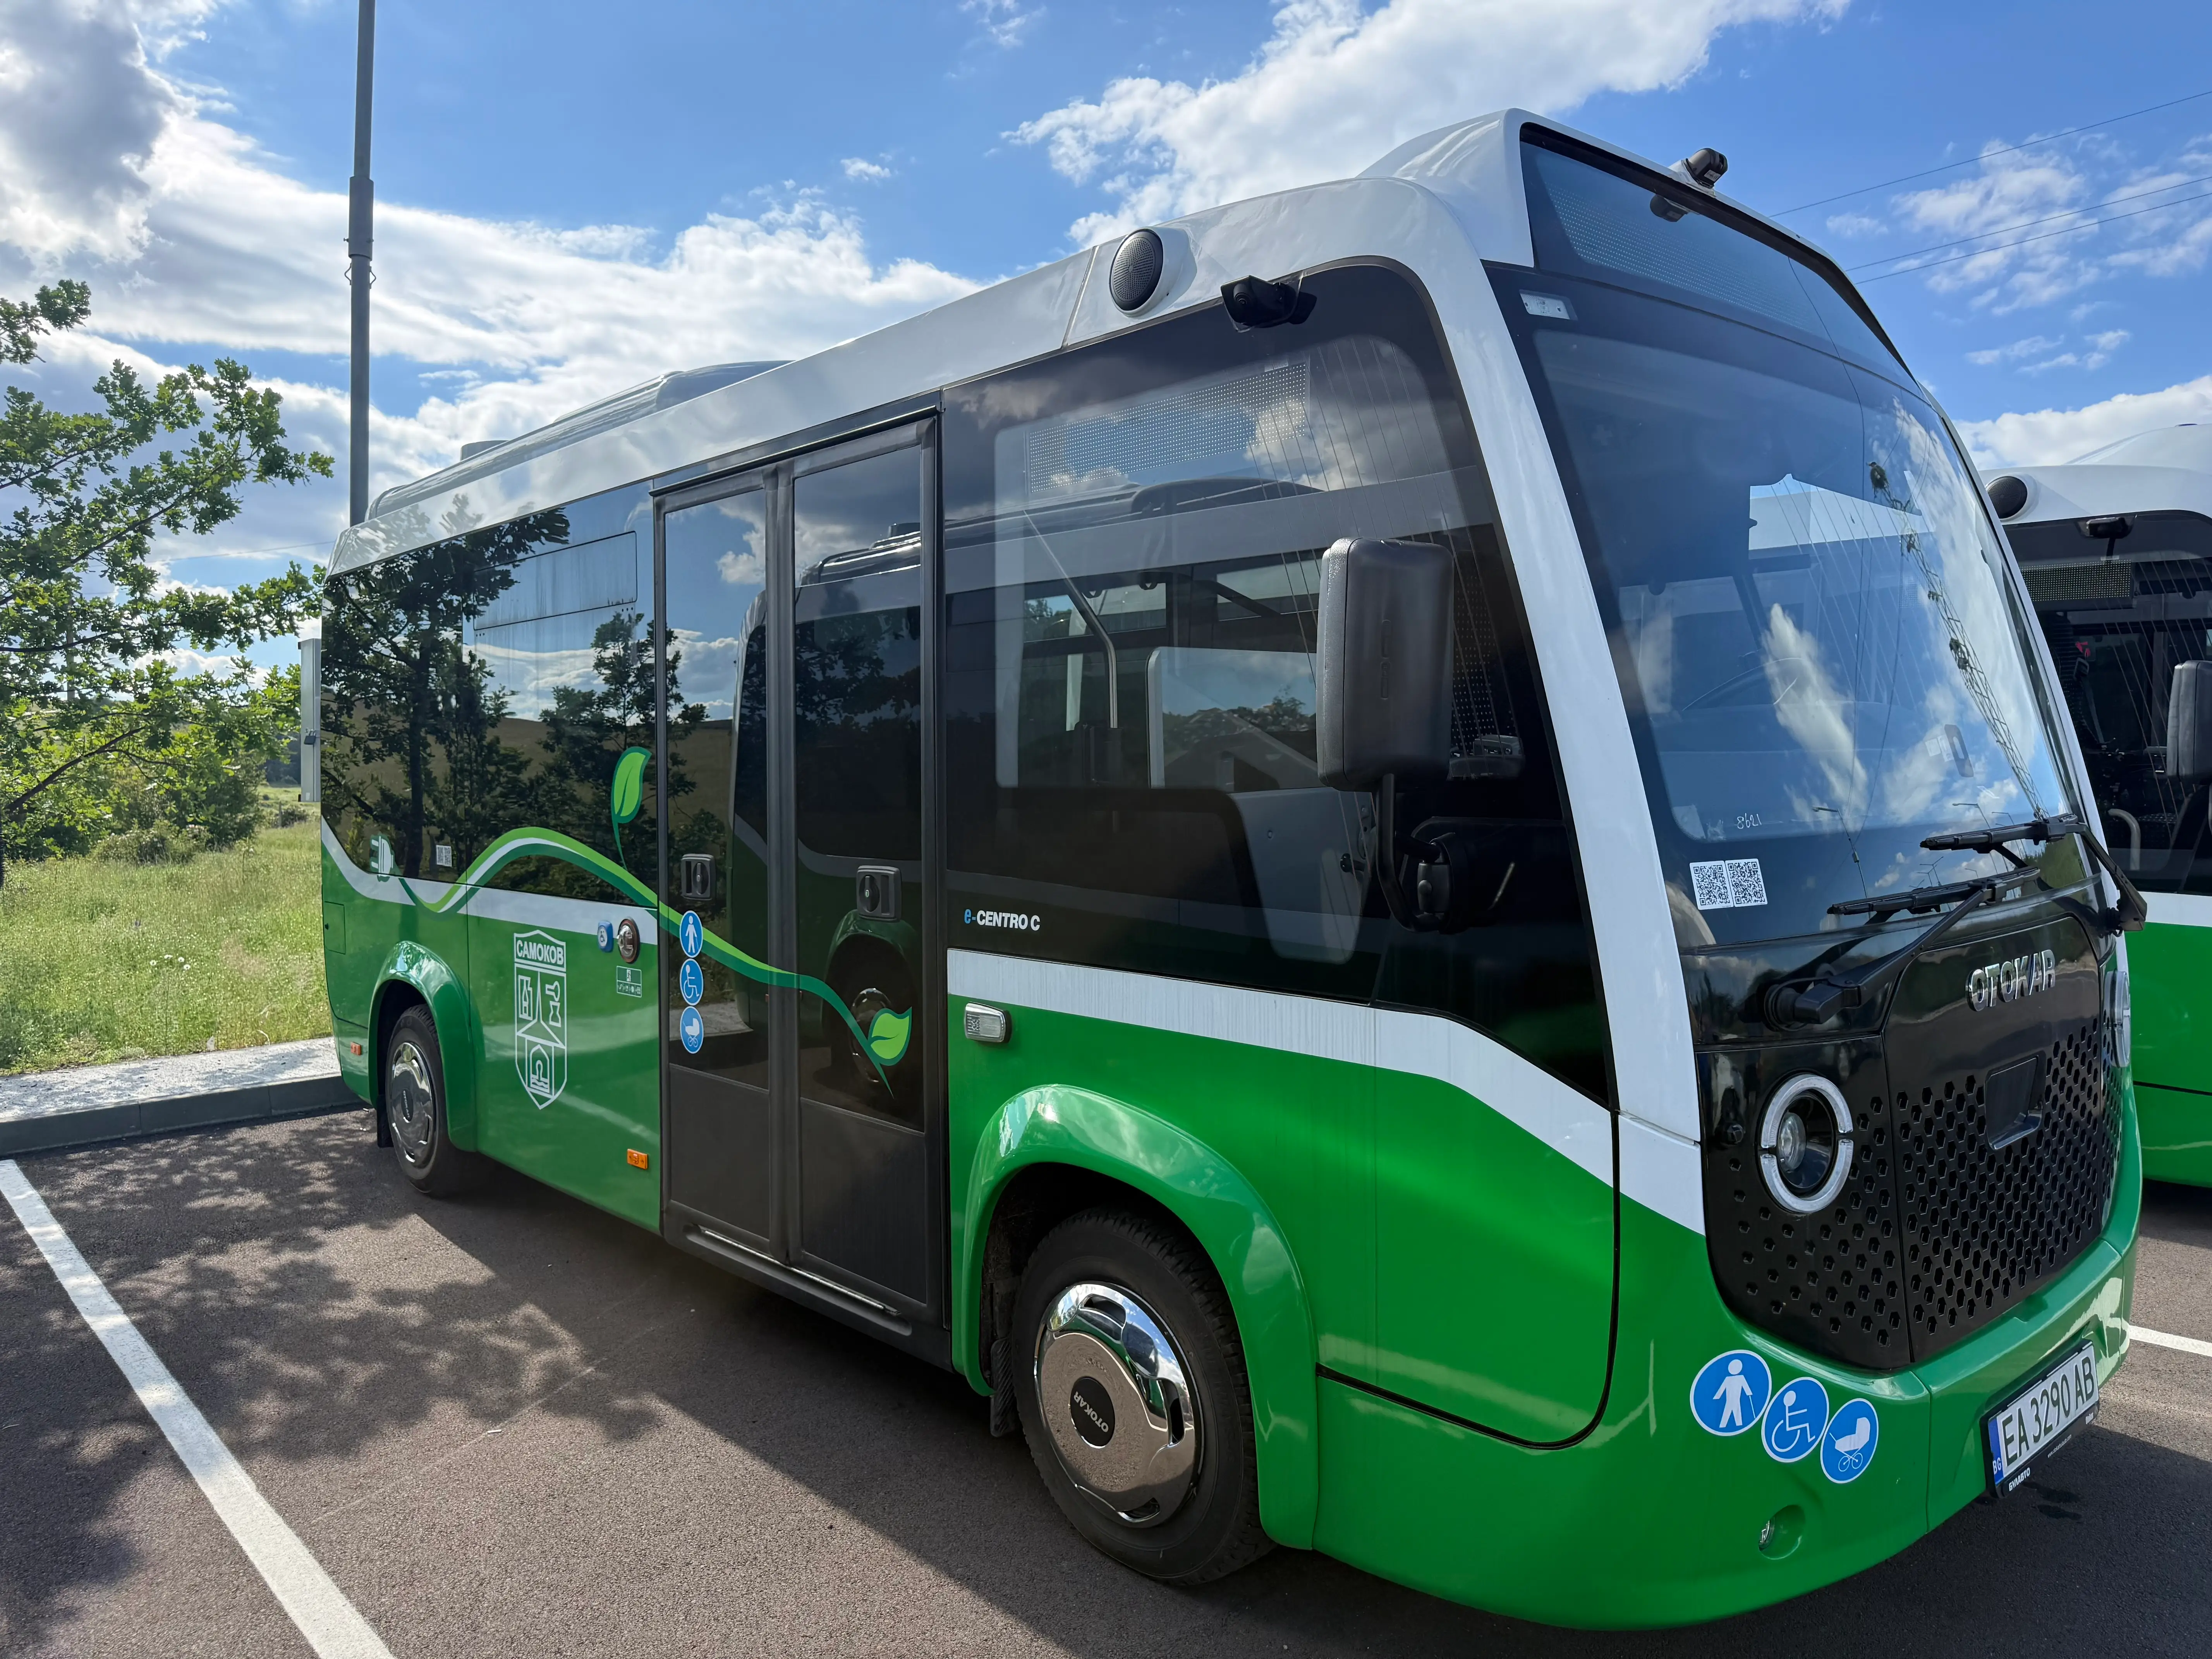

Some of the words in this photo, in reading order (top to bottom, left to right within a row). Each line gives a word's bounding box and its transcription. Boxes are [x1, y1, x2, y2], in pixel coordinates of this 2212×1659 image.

[1737, 812, 1762, 829] 8621
[964, 909, 1029, 930] e-CENTRO
[1030, 915, 1041, 931] C
[516, 939, 564, 965] САМОКОВ
[1966, 949, 2056, 1012] OTOKAR
[1073, 1391, 1109, 1433] OTOKAR
[2002, 1408, 2030, 1467] EA
[2030, 1374, 2071, 1443] 3290
[2075, 1356, 2094, 1410] AB
[1992, 1457, 2002, 1474] BG
[2009, 1467, 2030, 1492] БУЛАВТО
